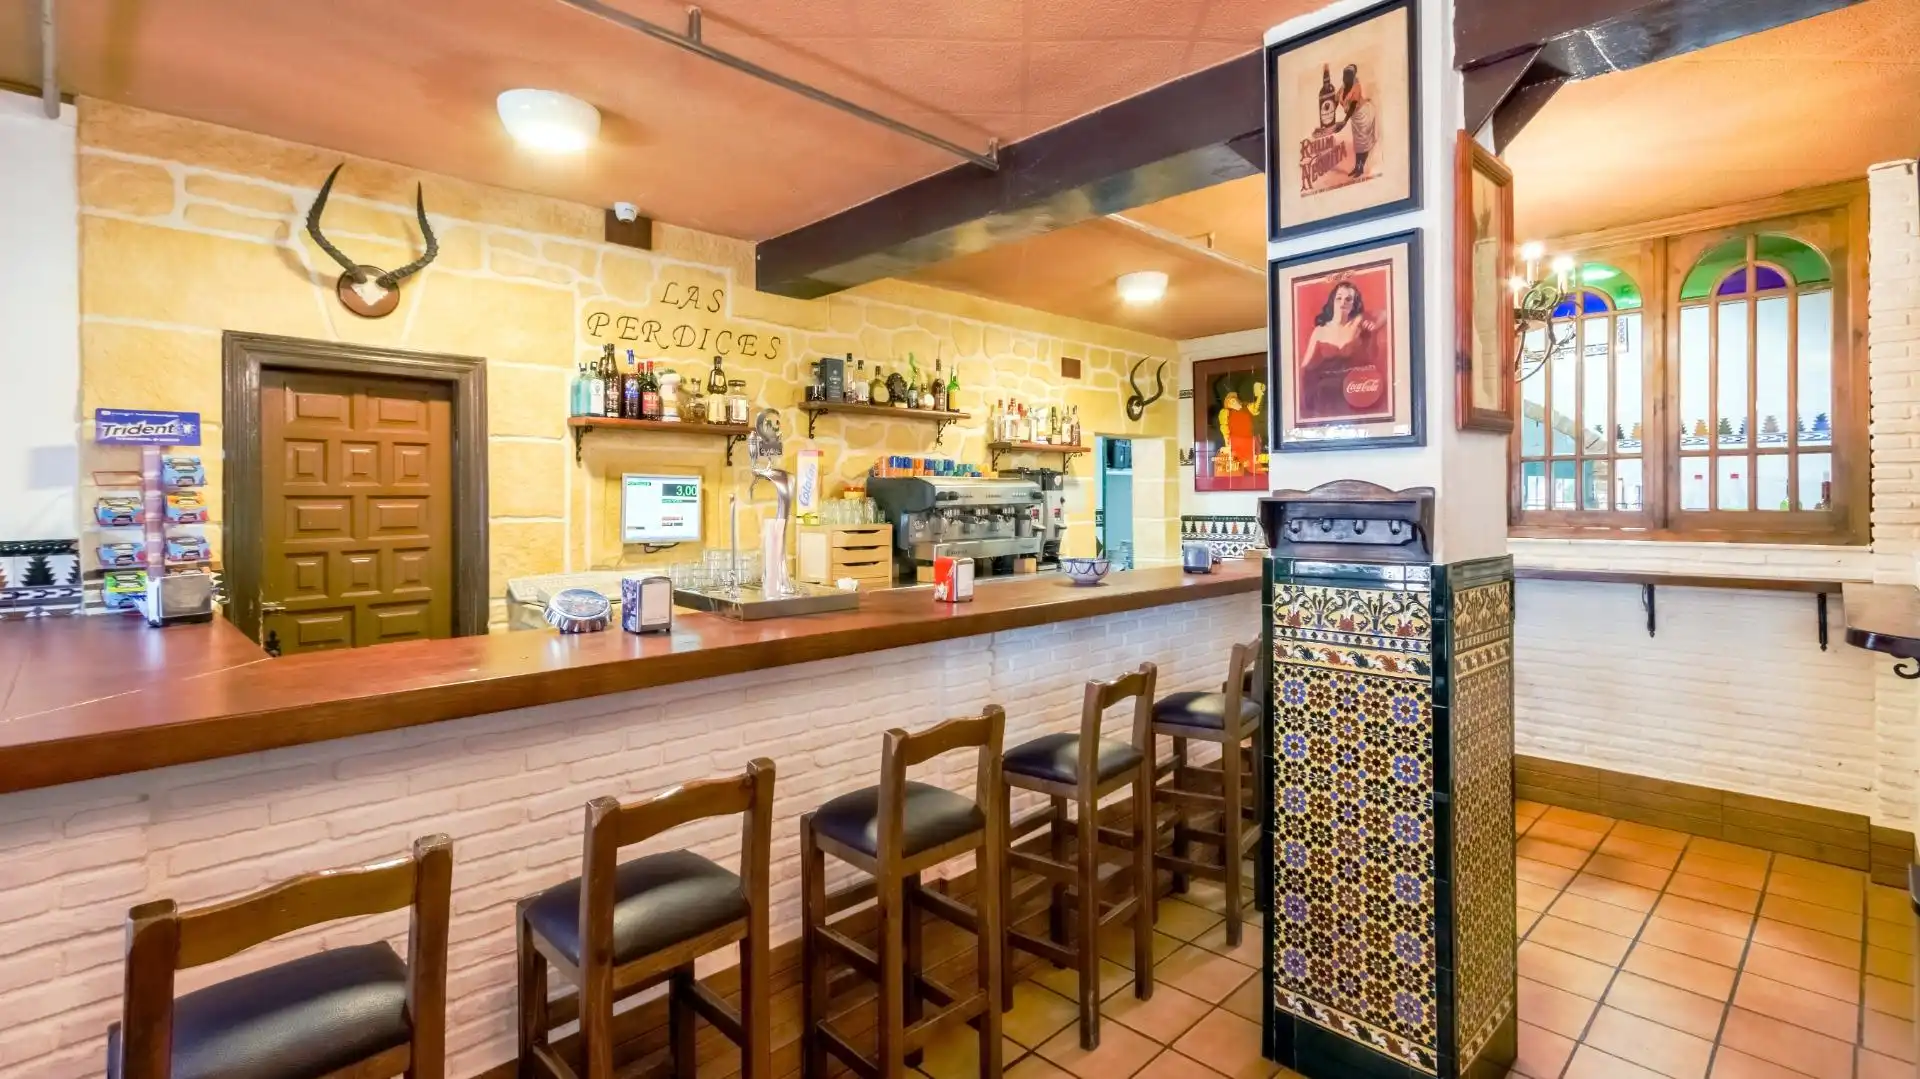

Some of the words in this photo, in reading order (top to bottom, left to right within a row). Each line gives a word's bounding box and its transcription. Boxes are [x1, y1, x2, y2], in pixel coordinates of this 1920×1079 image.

[660, 281, 724, 313] LAS
[587, 312, 781, 360] PERDICES
[102, 423, 176, 437] Trident
[676, 485, 697, 497] 3,00
